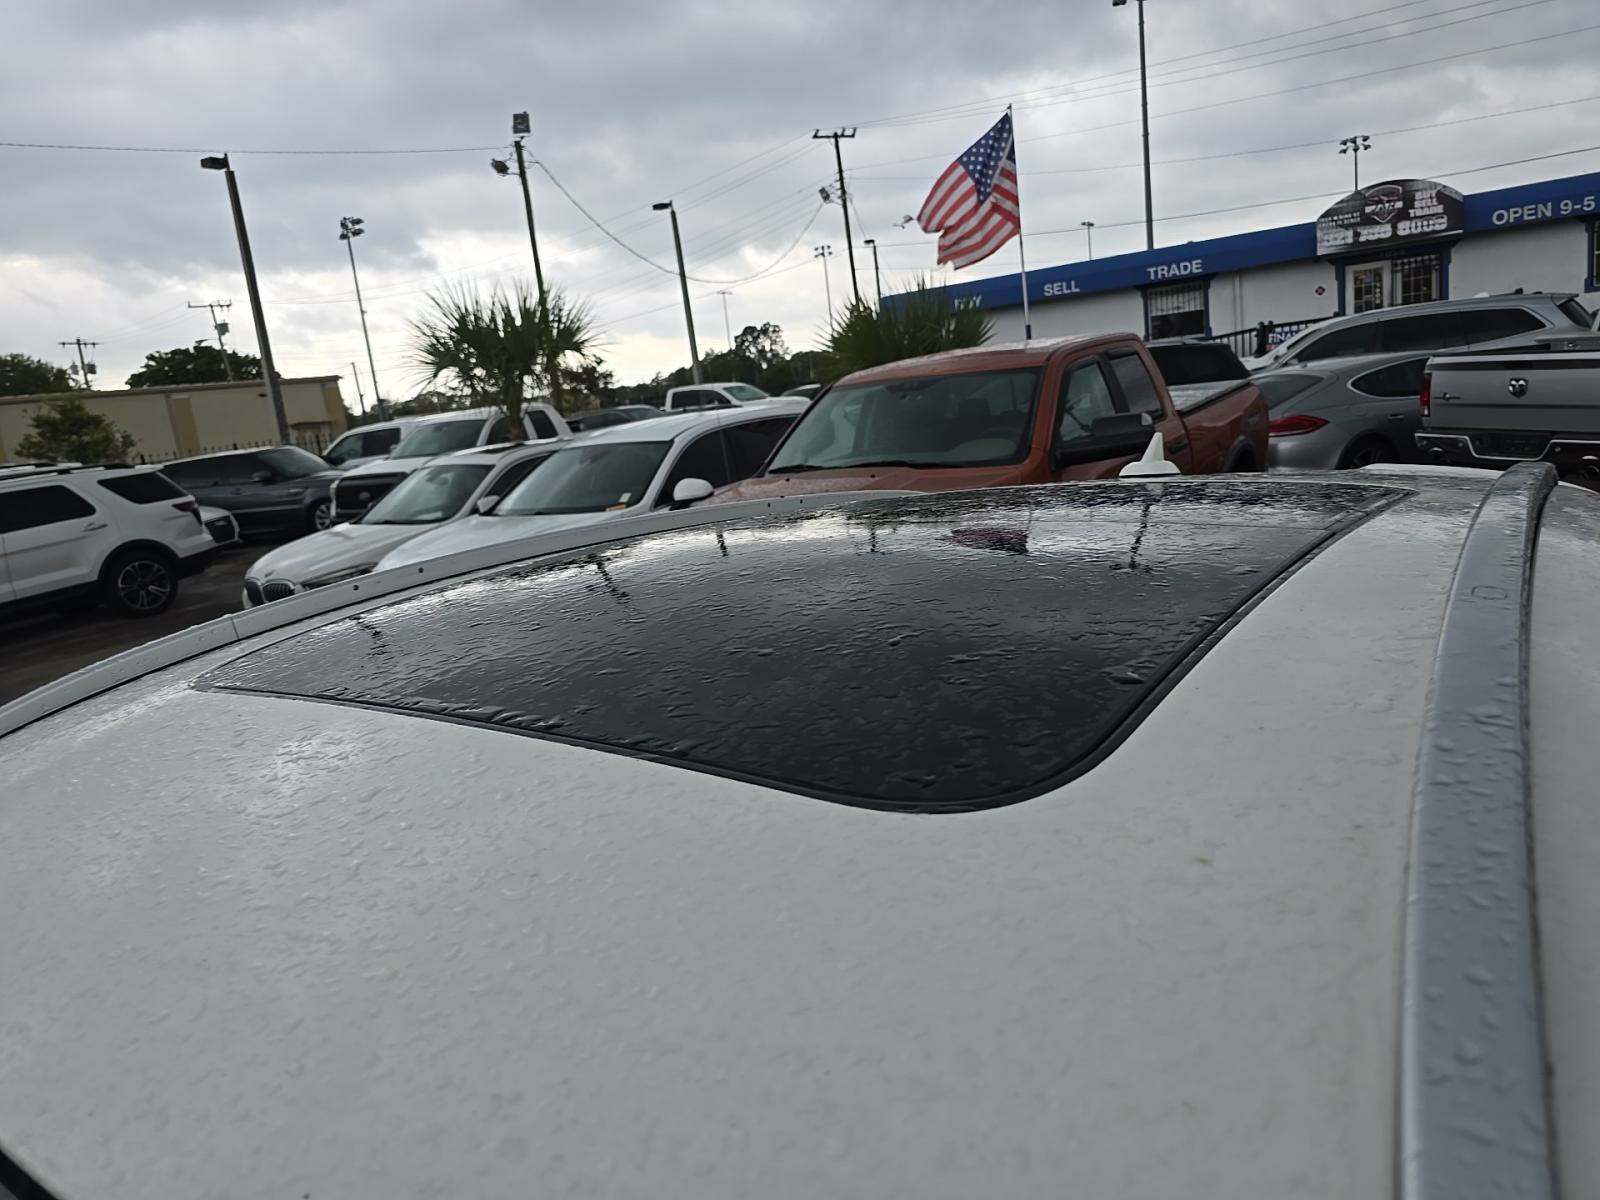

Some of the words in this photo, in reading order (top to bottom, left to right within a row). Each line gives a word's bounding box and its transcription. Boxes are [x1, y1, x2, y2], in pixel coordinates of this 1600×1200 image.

[1492, 202, 1552, 225] OPEN
[1560, 196, 1596, 215] 9-5
[1146, 260, 1203, 280] TRADE
[1043, 280, 1080, 297] SELL
